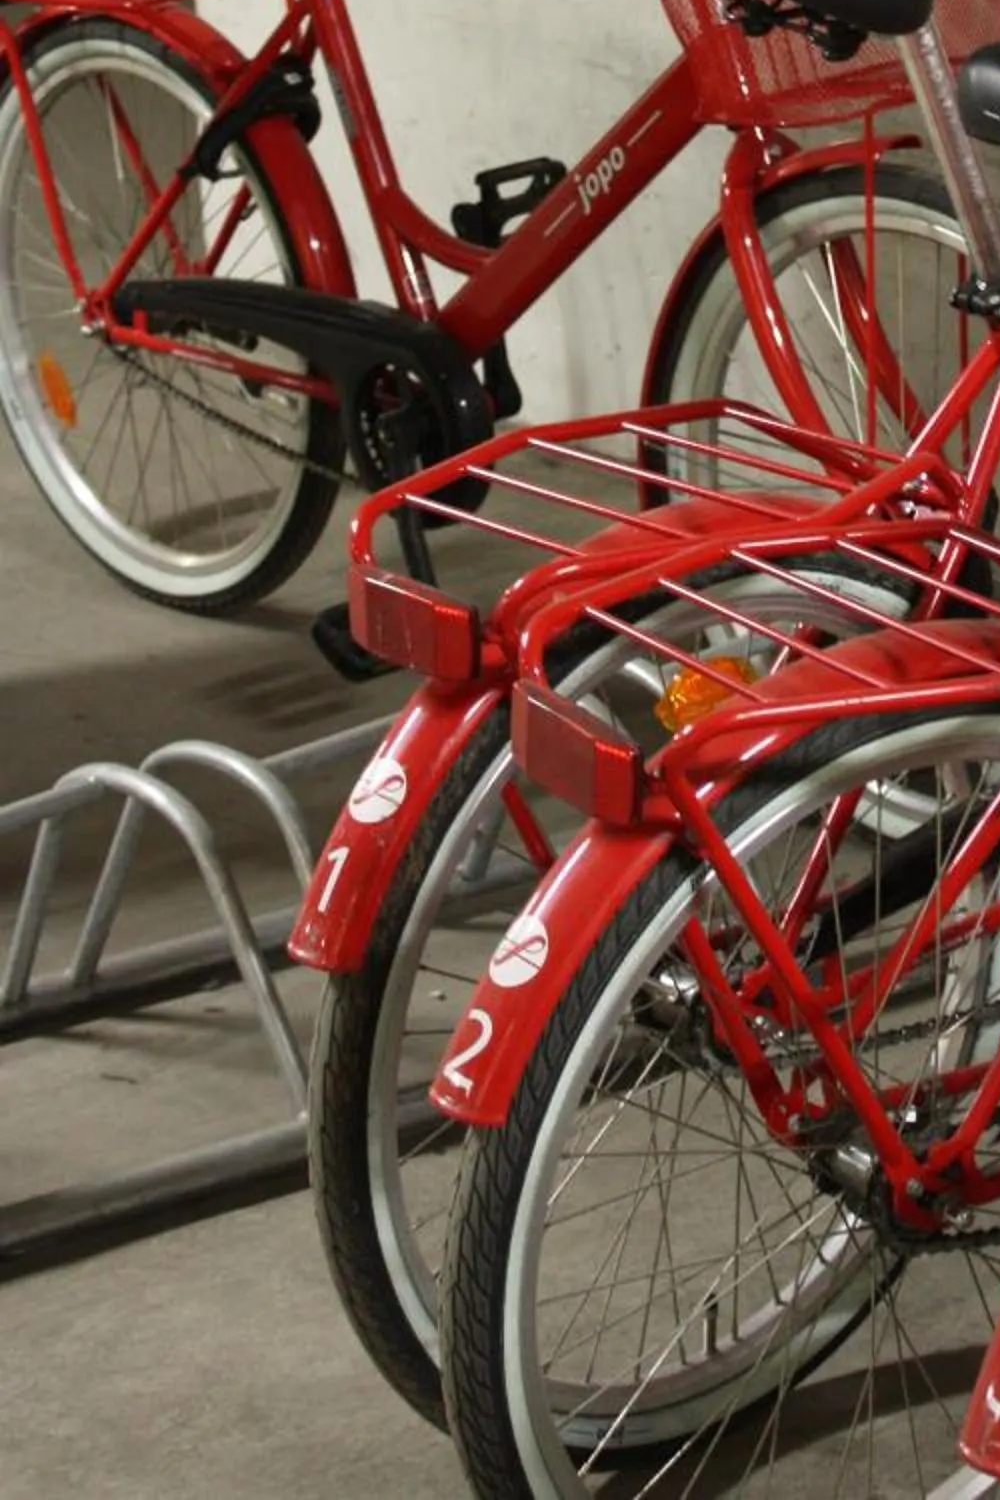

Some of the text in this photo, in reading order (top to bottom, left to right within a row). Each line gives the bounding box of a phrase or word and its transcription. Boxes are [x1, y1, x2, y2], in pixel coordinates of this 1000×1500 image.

[574, 146, 625, 216] jopo
[316, 845, 350, 913] 1
[442, 1008, 493, 1096] 2
